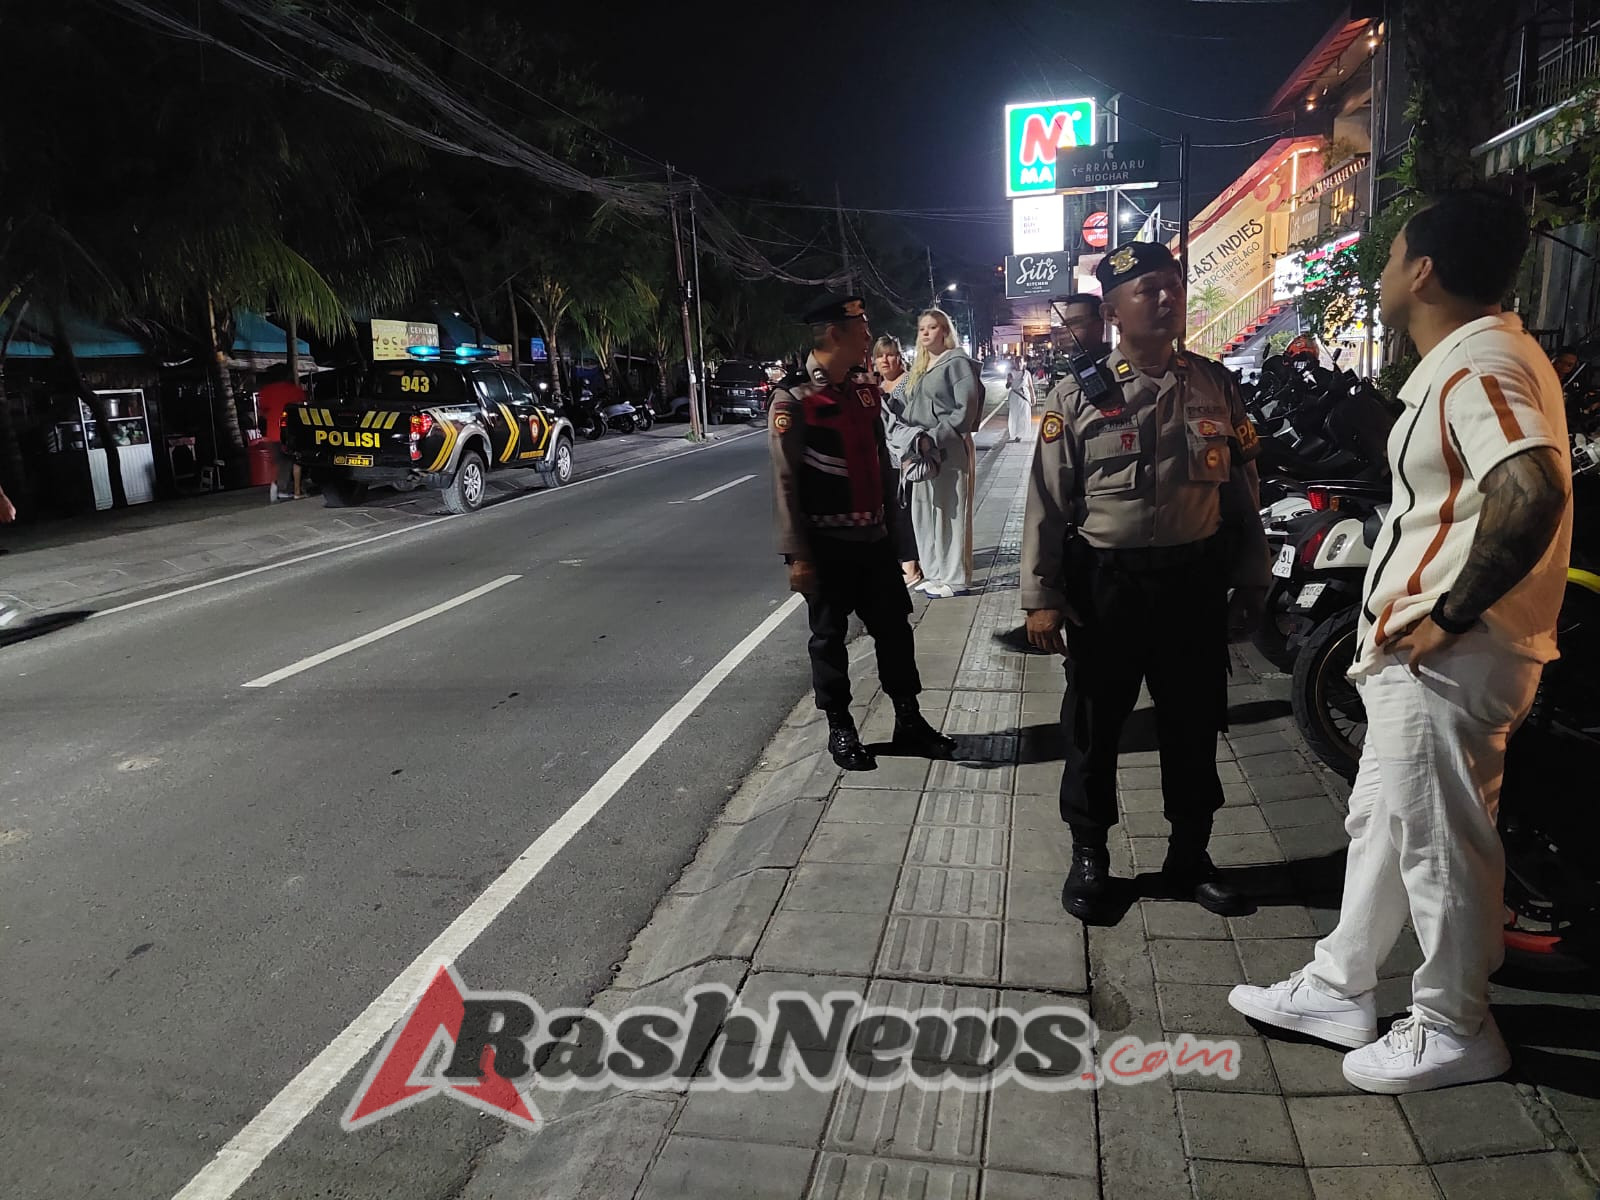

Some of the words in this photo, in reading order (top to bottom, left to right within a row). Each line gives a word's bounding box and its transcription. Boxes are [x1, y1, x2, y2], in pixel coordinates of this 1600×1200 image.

[1020, 167, 1056, 185] MA
[1085, 171, 1129, 182] BIOCHAR
[1187, 251, 1218, 284] EAST
[1216, 219, 1263, 258] INDIES
[1203, 241, 1260, 286] ARCHIPELAGO
[401, 375, 430, 393] 943
[315, 430, 380, 448] POLISI
